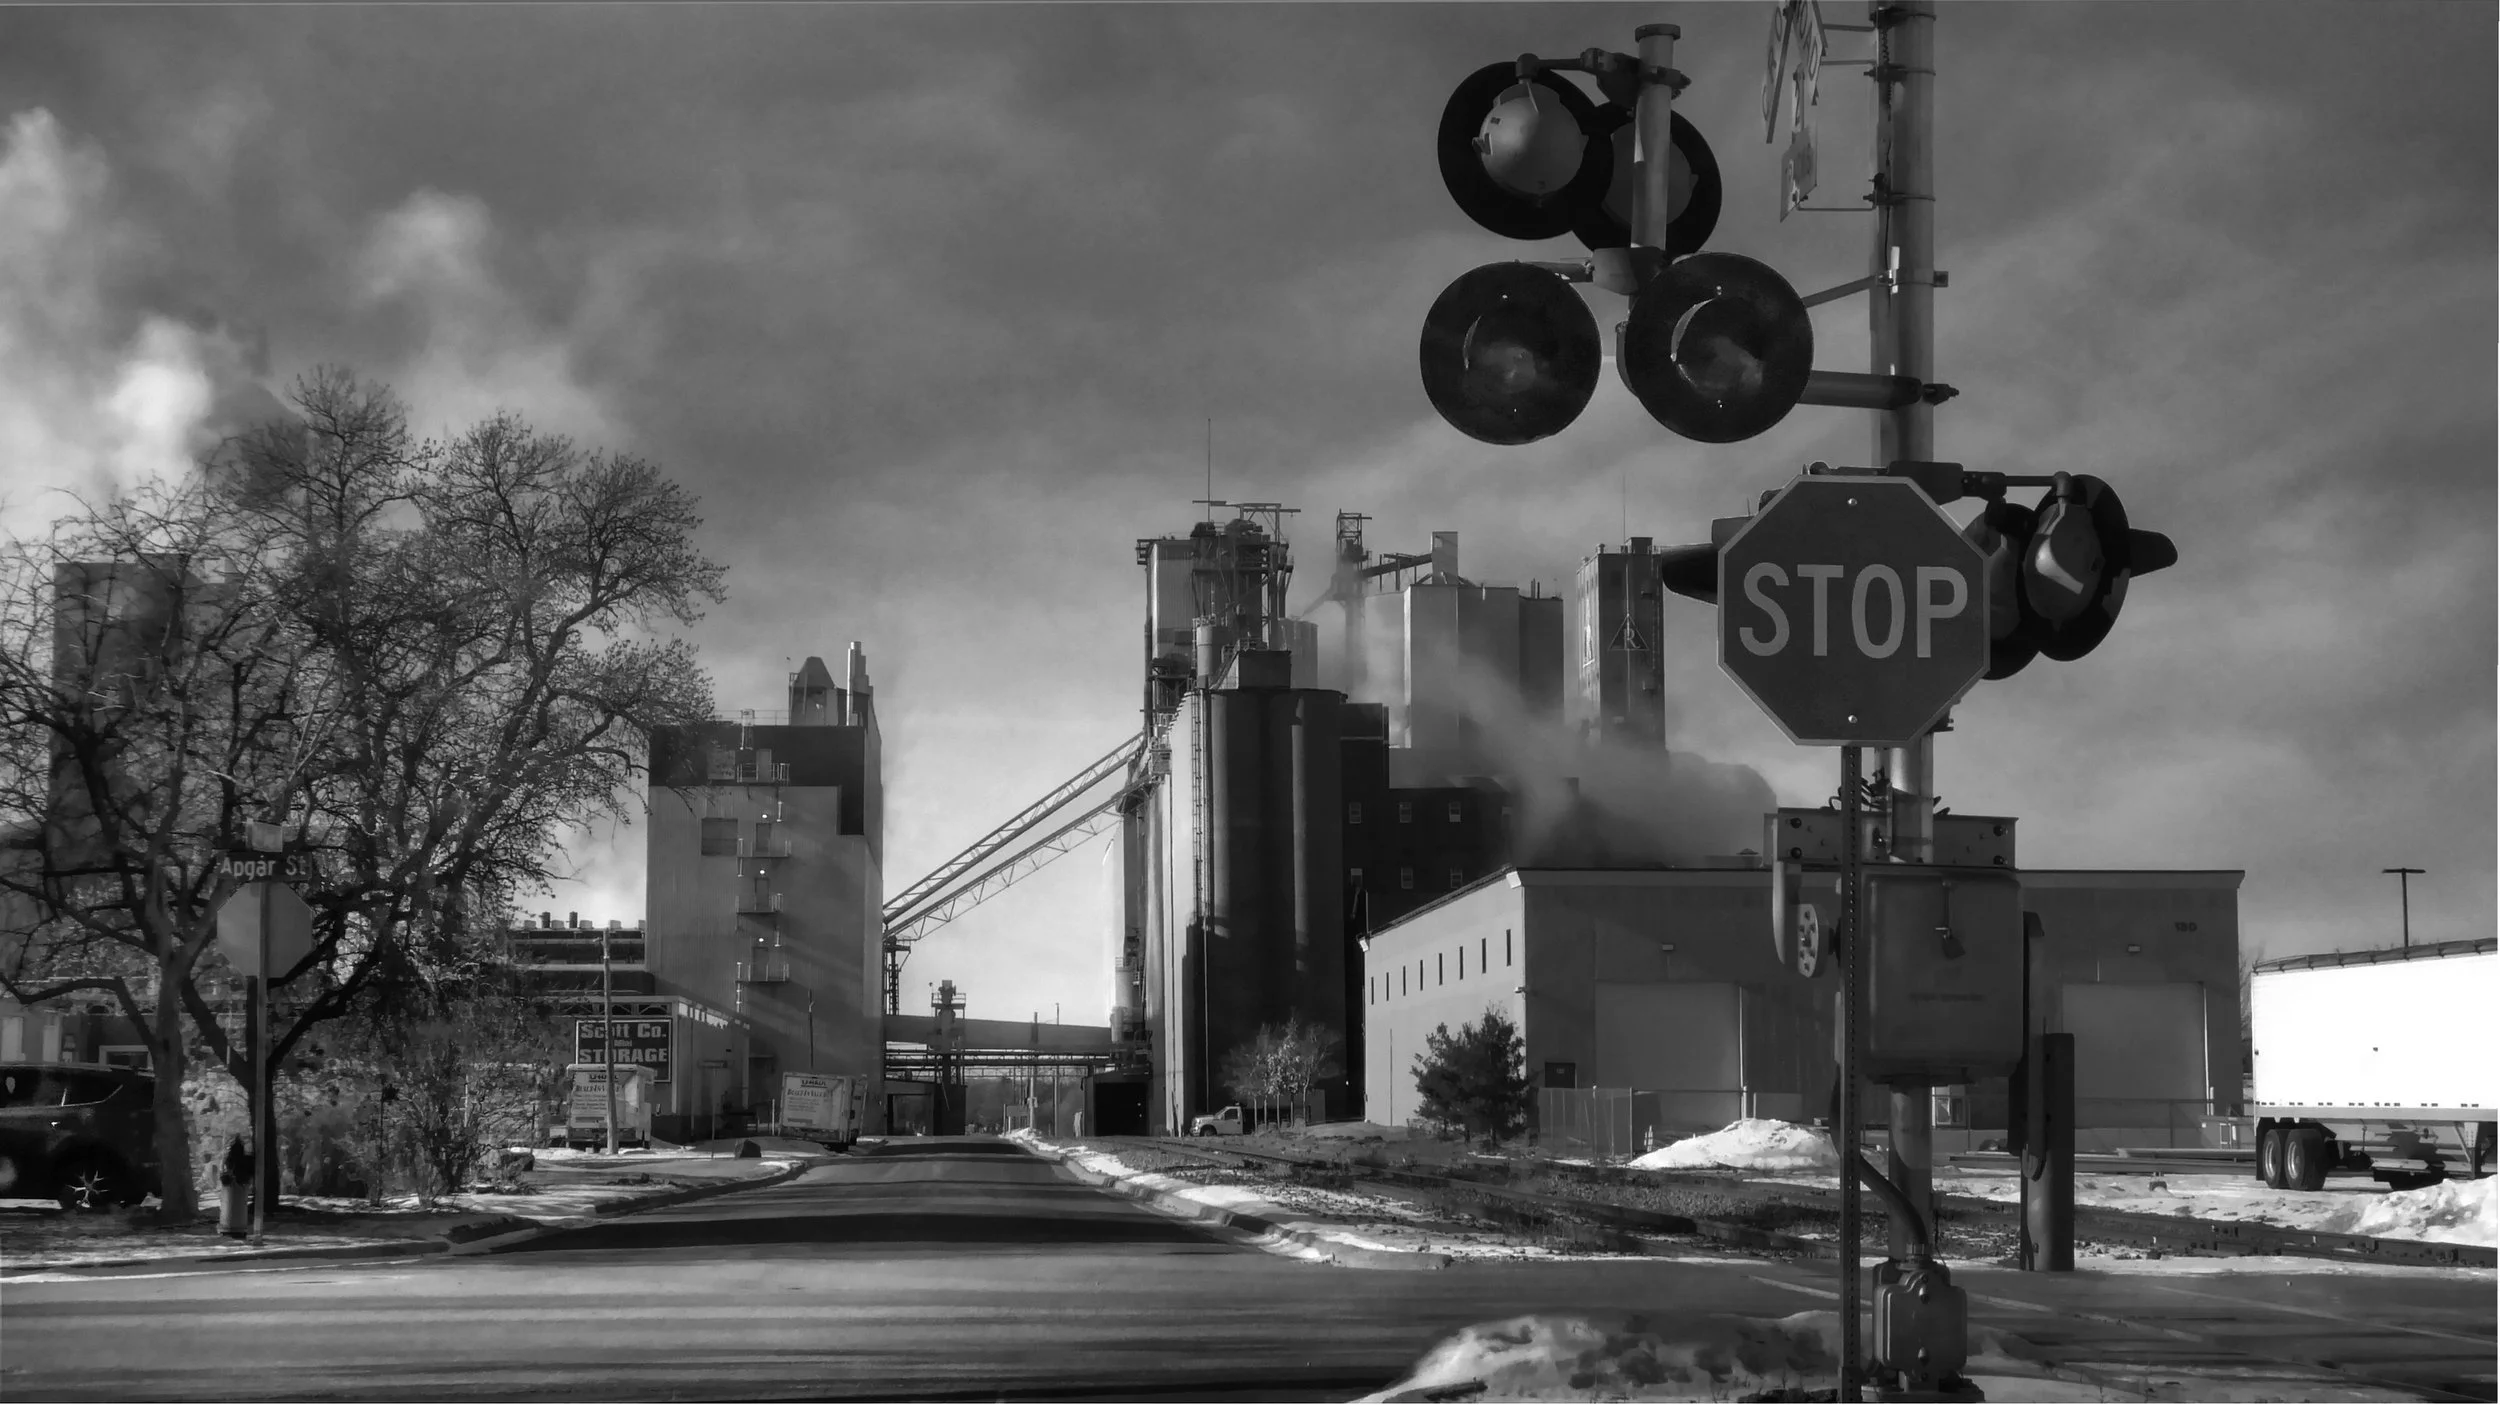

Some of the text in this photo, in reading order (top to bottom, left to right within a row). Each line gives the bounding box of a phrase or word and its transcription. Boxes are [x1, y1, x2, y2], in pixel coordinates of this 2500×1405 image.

[1739, 562, 1968, 659] STOP
[219, 854, 306, 881] Apgar St
[637, 1023, 667, 1038] Co.
